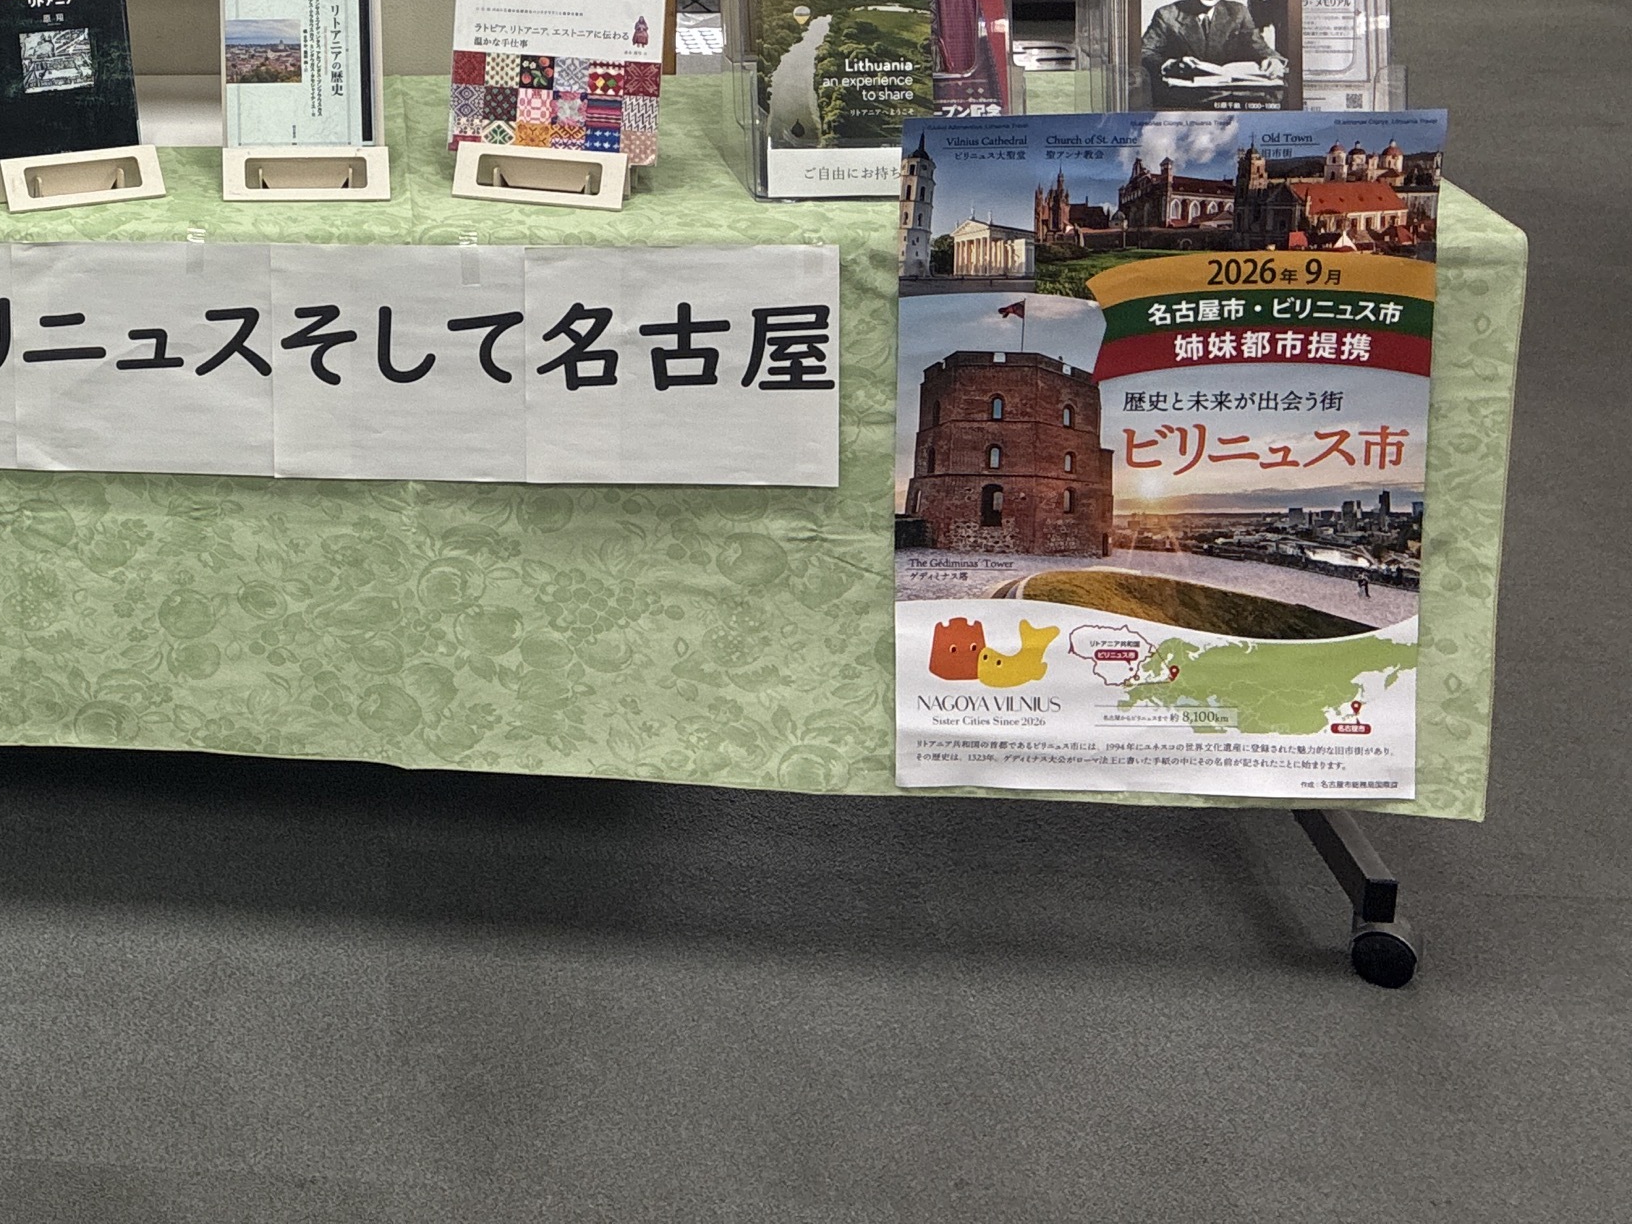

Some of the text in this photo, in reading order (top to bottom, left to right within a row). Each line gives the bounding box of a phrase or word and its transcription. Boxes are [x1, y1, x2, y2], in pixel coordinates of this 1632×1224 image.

[330, 4, 344, 96] リトアニアの歴史
[823, 75, 913, 90] an experience
[862, 88, 914, 101] to share
[946, 135, 1028, 146] Vilnius Cathedral
[1046, 135, 1083, 145] Church
[1085, 135, 1096, 145] of
[1112, 135, 1138, 145] Anne
[1261, 133, 1313, 143] Old Town
[1147, 297, 1404, 327] 名古屋市・ビリニュス市
[1173, 330, 1372, 362] 姉妹都市提携
[1122, 390, 1344, 413] 歴史と未来が出会う街
[1122, 423, 1409, 476] ビリニュス市
[909, 558, 1013, 568] The Tower
[918, 695, 1061, 712] NAGOYA VILNIUS
[932, 716, 1046, 727] Sister Cities Since 2026
[1170, 711, 1229, 724] 約 8,100km
